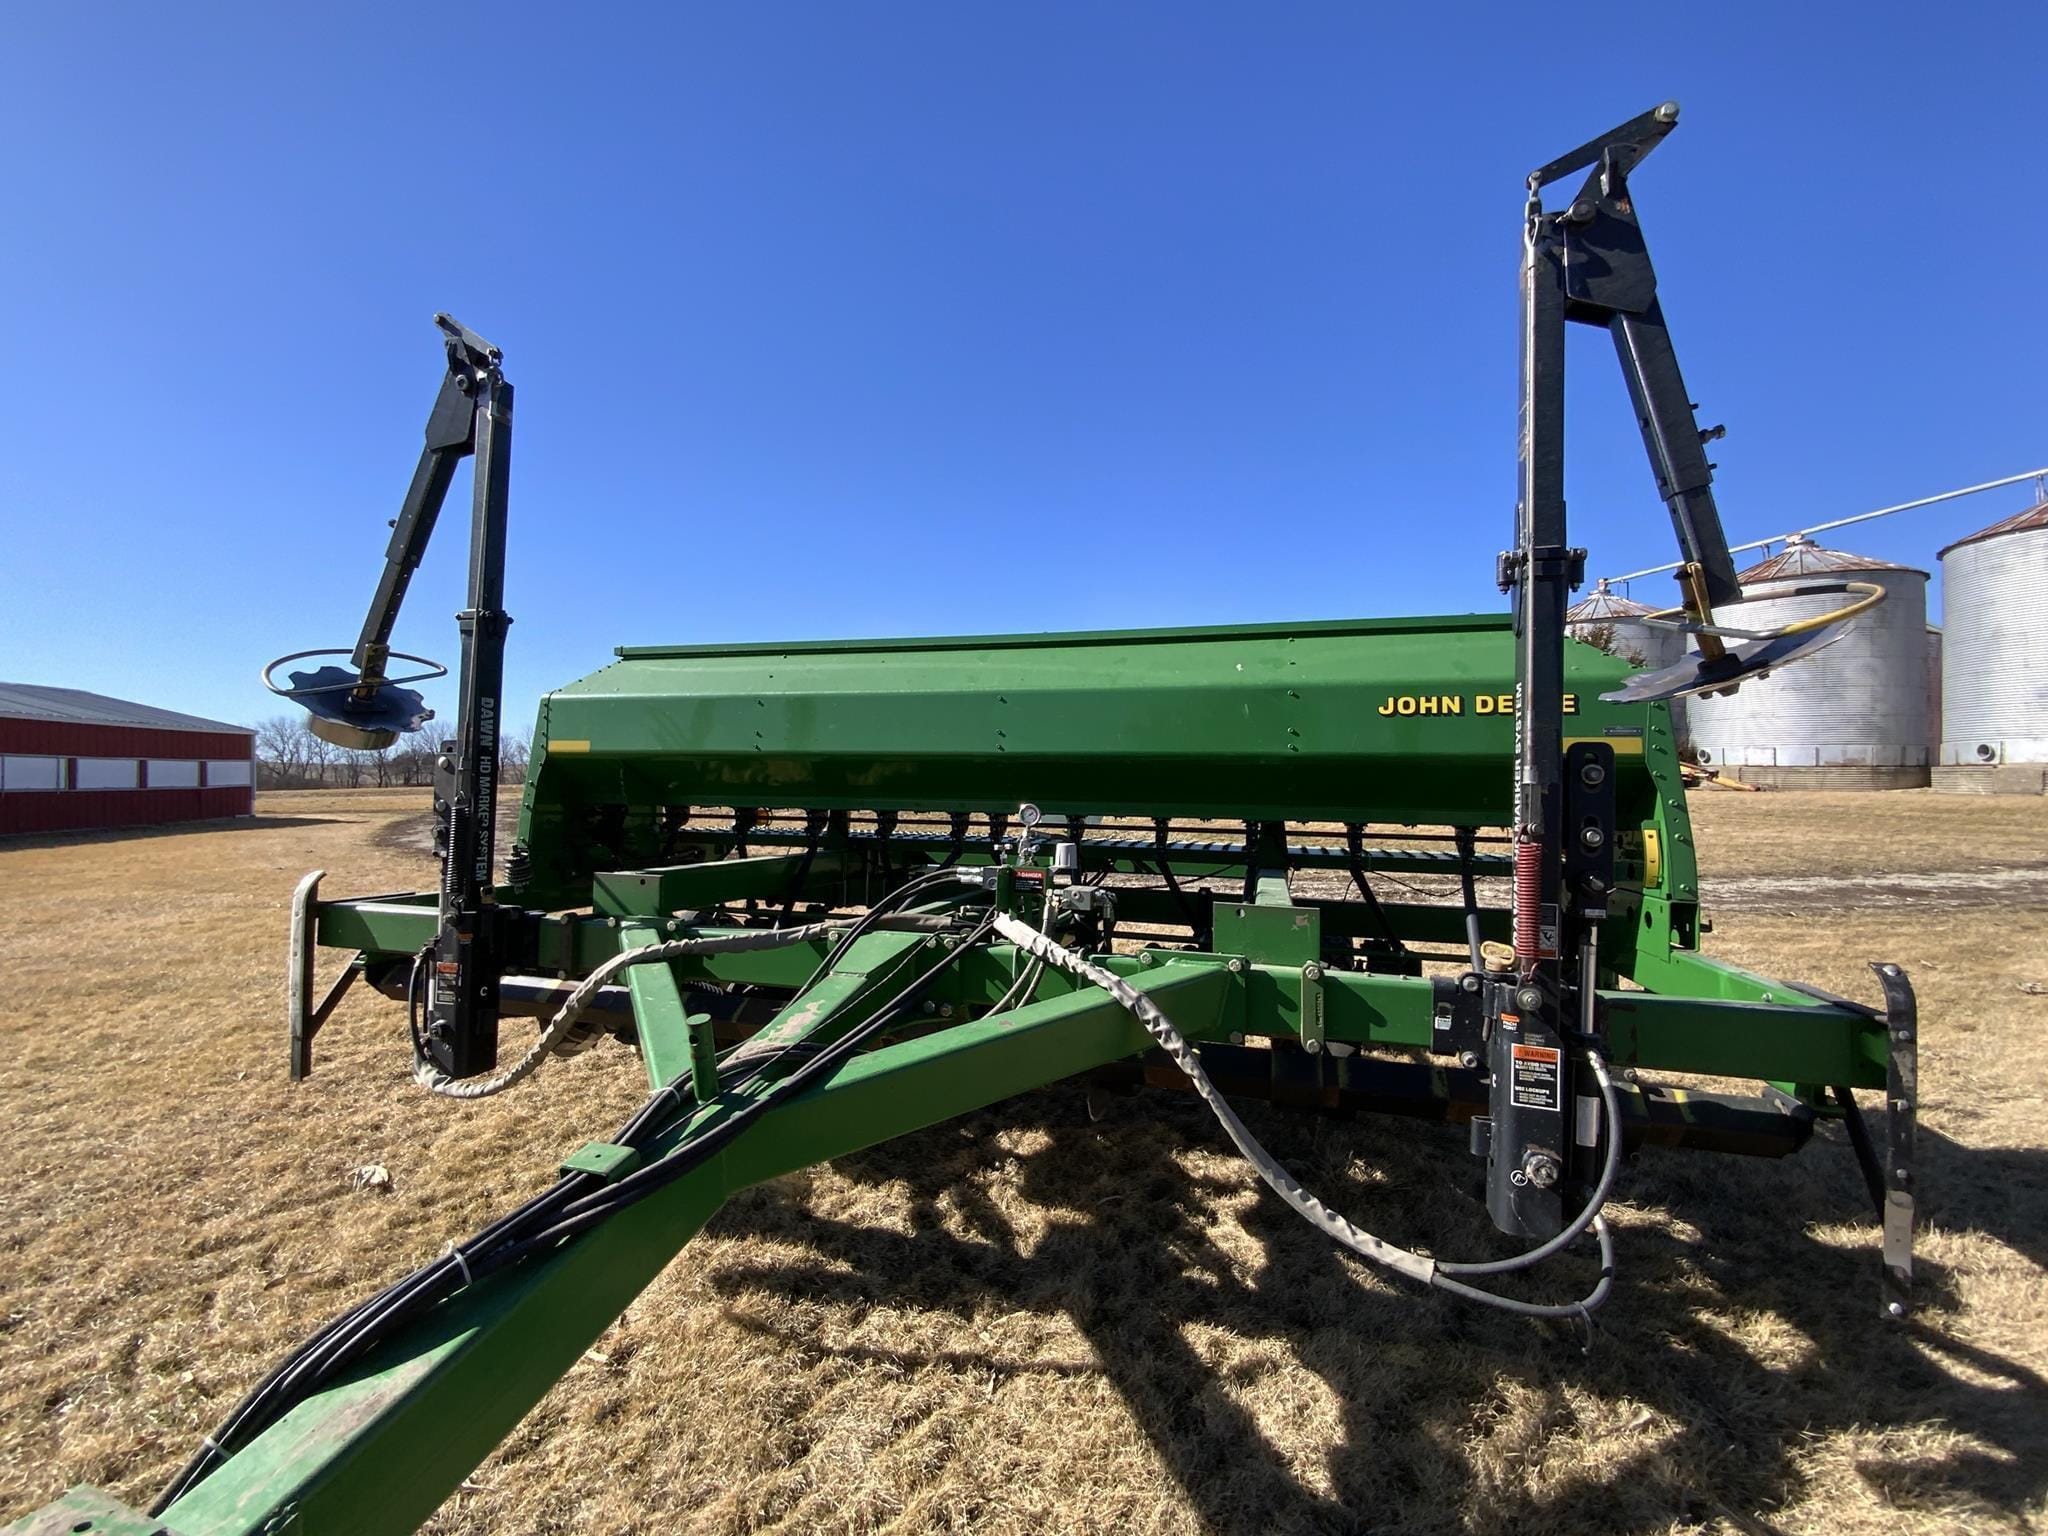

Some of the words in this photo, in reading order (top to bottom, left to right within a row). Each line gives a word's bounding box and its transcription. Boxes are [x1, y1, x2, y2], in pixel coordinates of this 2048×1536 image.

[481, 697, 494, 746] DAWN
[1378, 696, 1462, 715] JOHN
[1475, 694, 1576, 714] DEE
[480, 756, 492, 773] HD
[478, 776, 491, 827] MARKER
[475, 828, 489, 881] SYSTEM
[1524, 1050, 1556, 1061] WARNING
